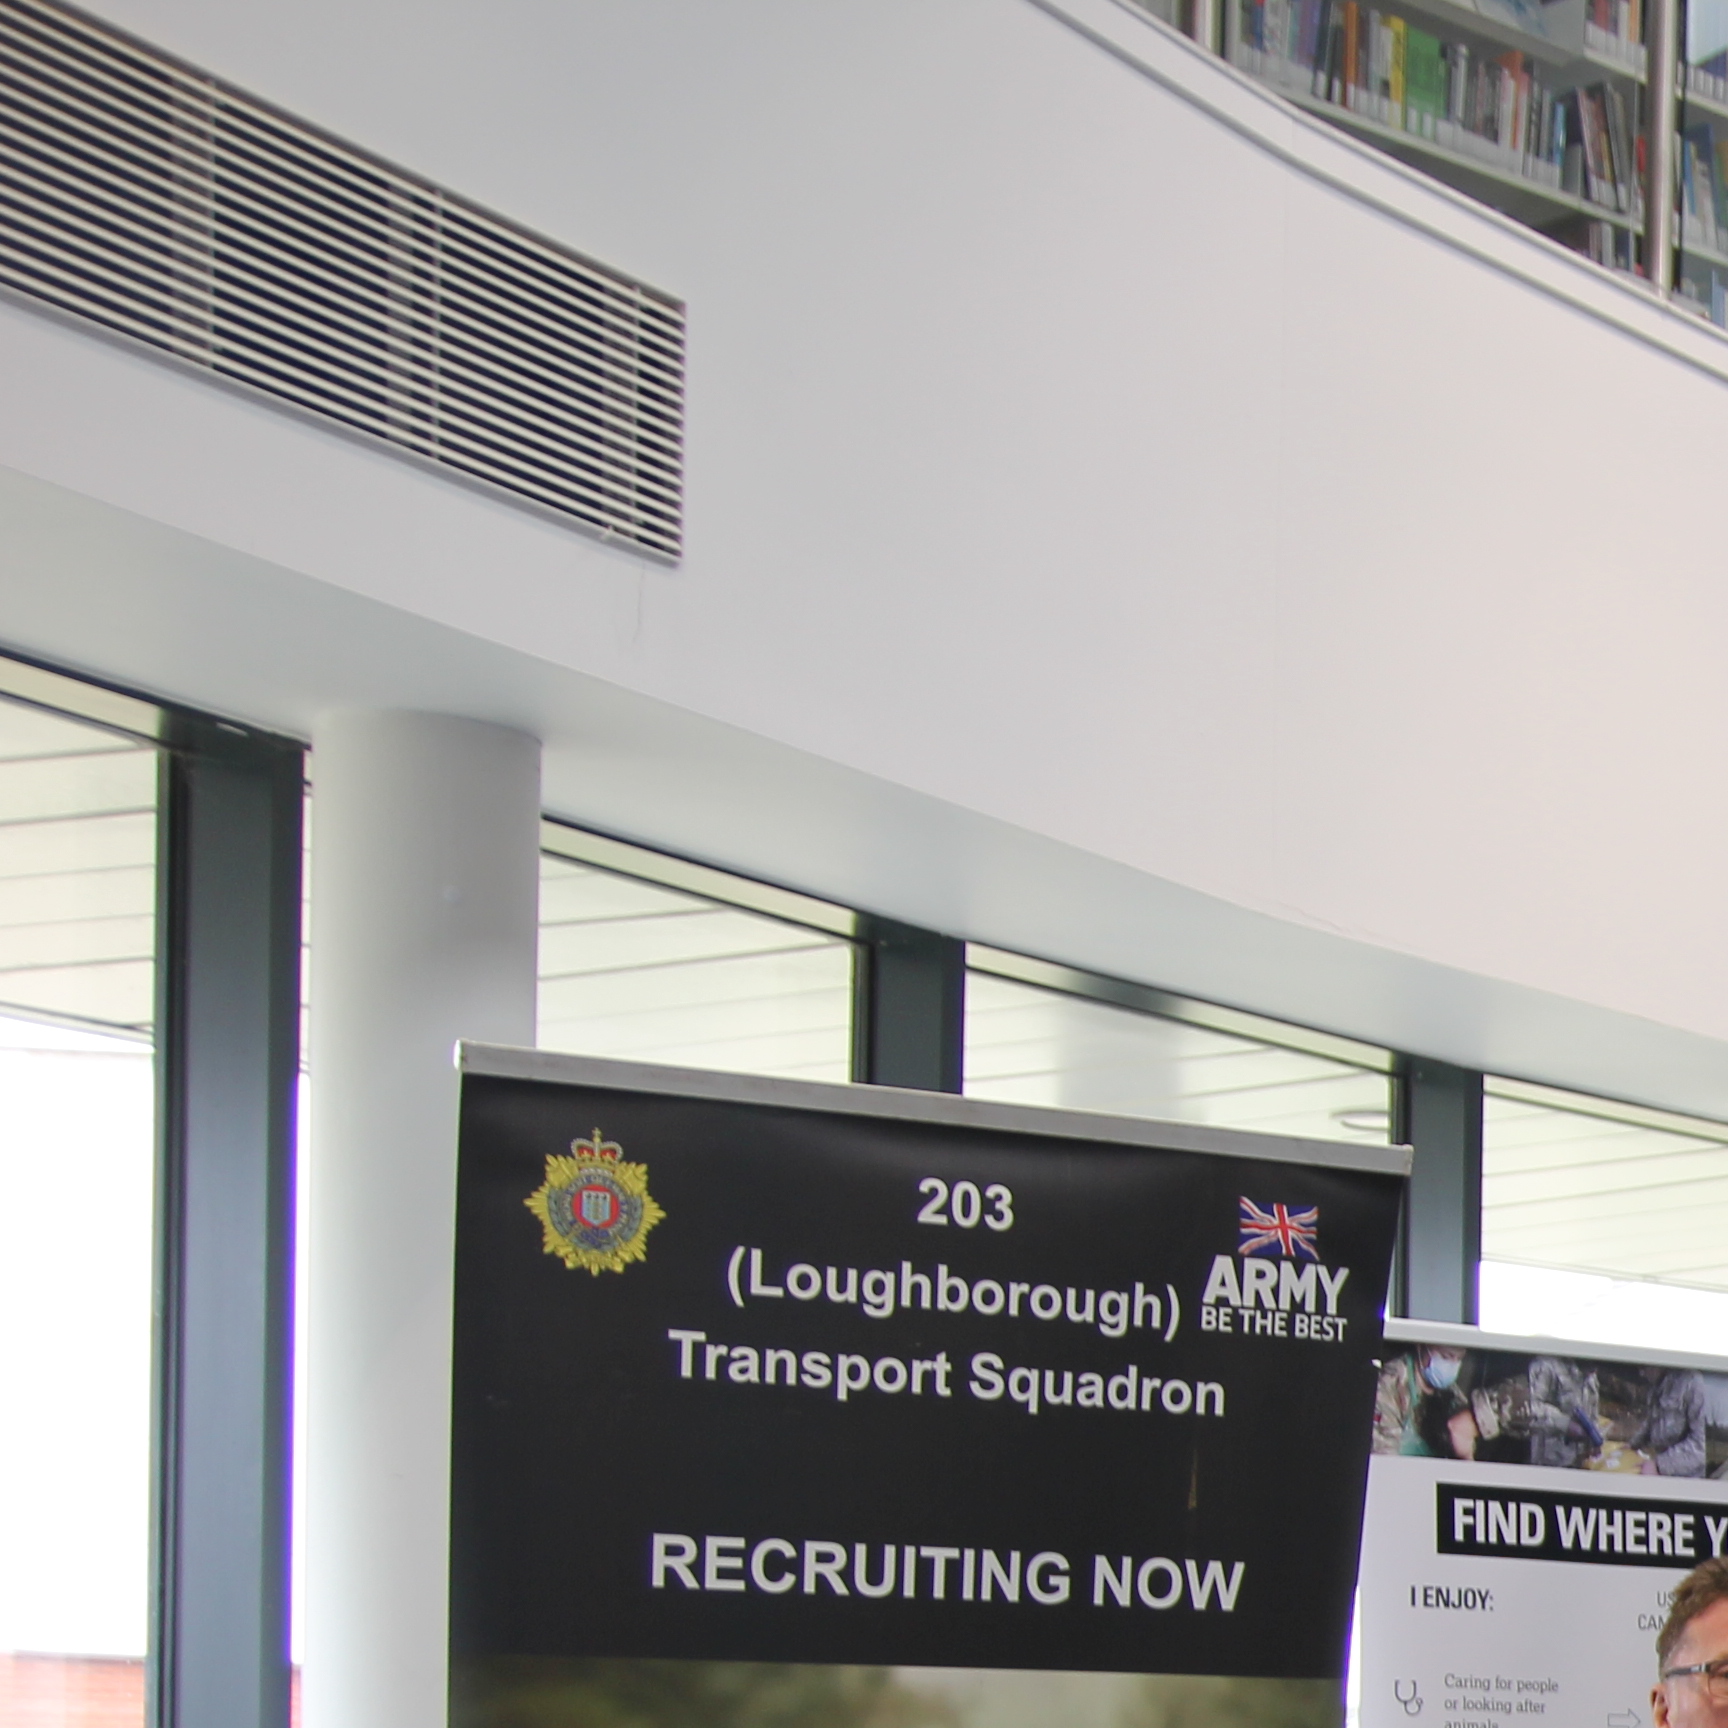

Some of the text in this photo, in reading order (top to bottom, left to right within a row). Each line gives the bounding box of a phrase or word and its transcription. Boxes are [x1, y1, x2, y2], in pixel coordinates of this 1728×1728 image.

[917, 1176, 1015, 1232] 203
[727, 1246, 1181, 1342] (Loughborough)
[1202, 1255, 1349, 1314] ARMY
[1201, 1307, 1347, 1342] BE THE BEST
[667, 1329, 1226, 1416] Transport Squadron
[1453, 1498, 1545, 1546] FIND
[1555, 1503, 1696, 1558] WHERE
[650, 1533, 1245, 1612] RECRUITING NOW
[1410, 1585, 1494, 1612] I ENJOY:
[1444, 1673, 1559, 1695] Caring for people
[1444, 1695, 1546, 1715] or looking after
